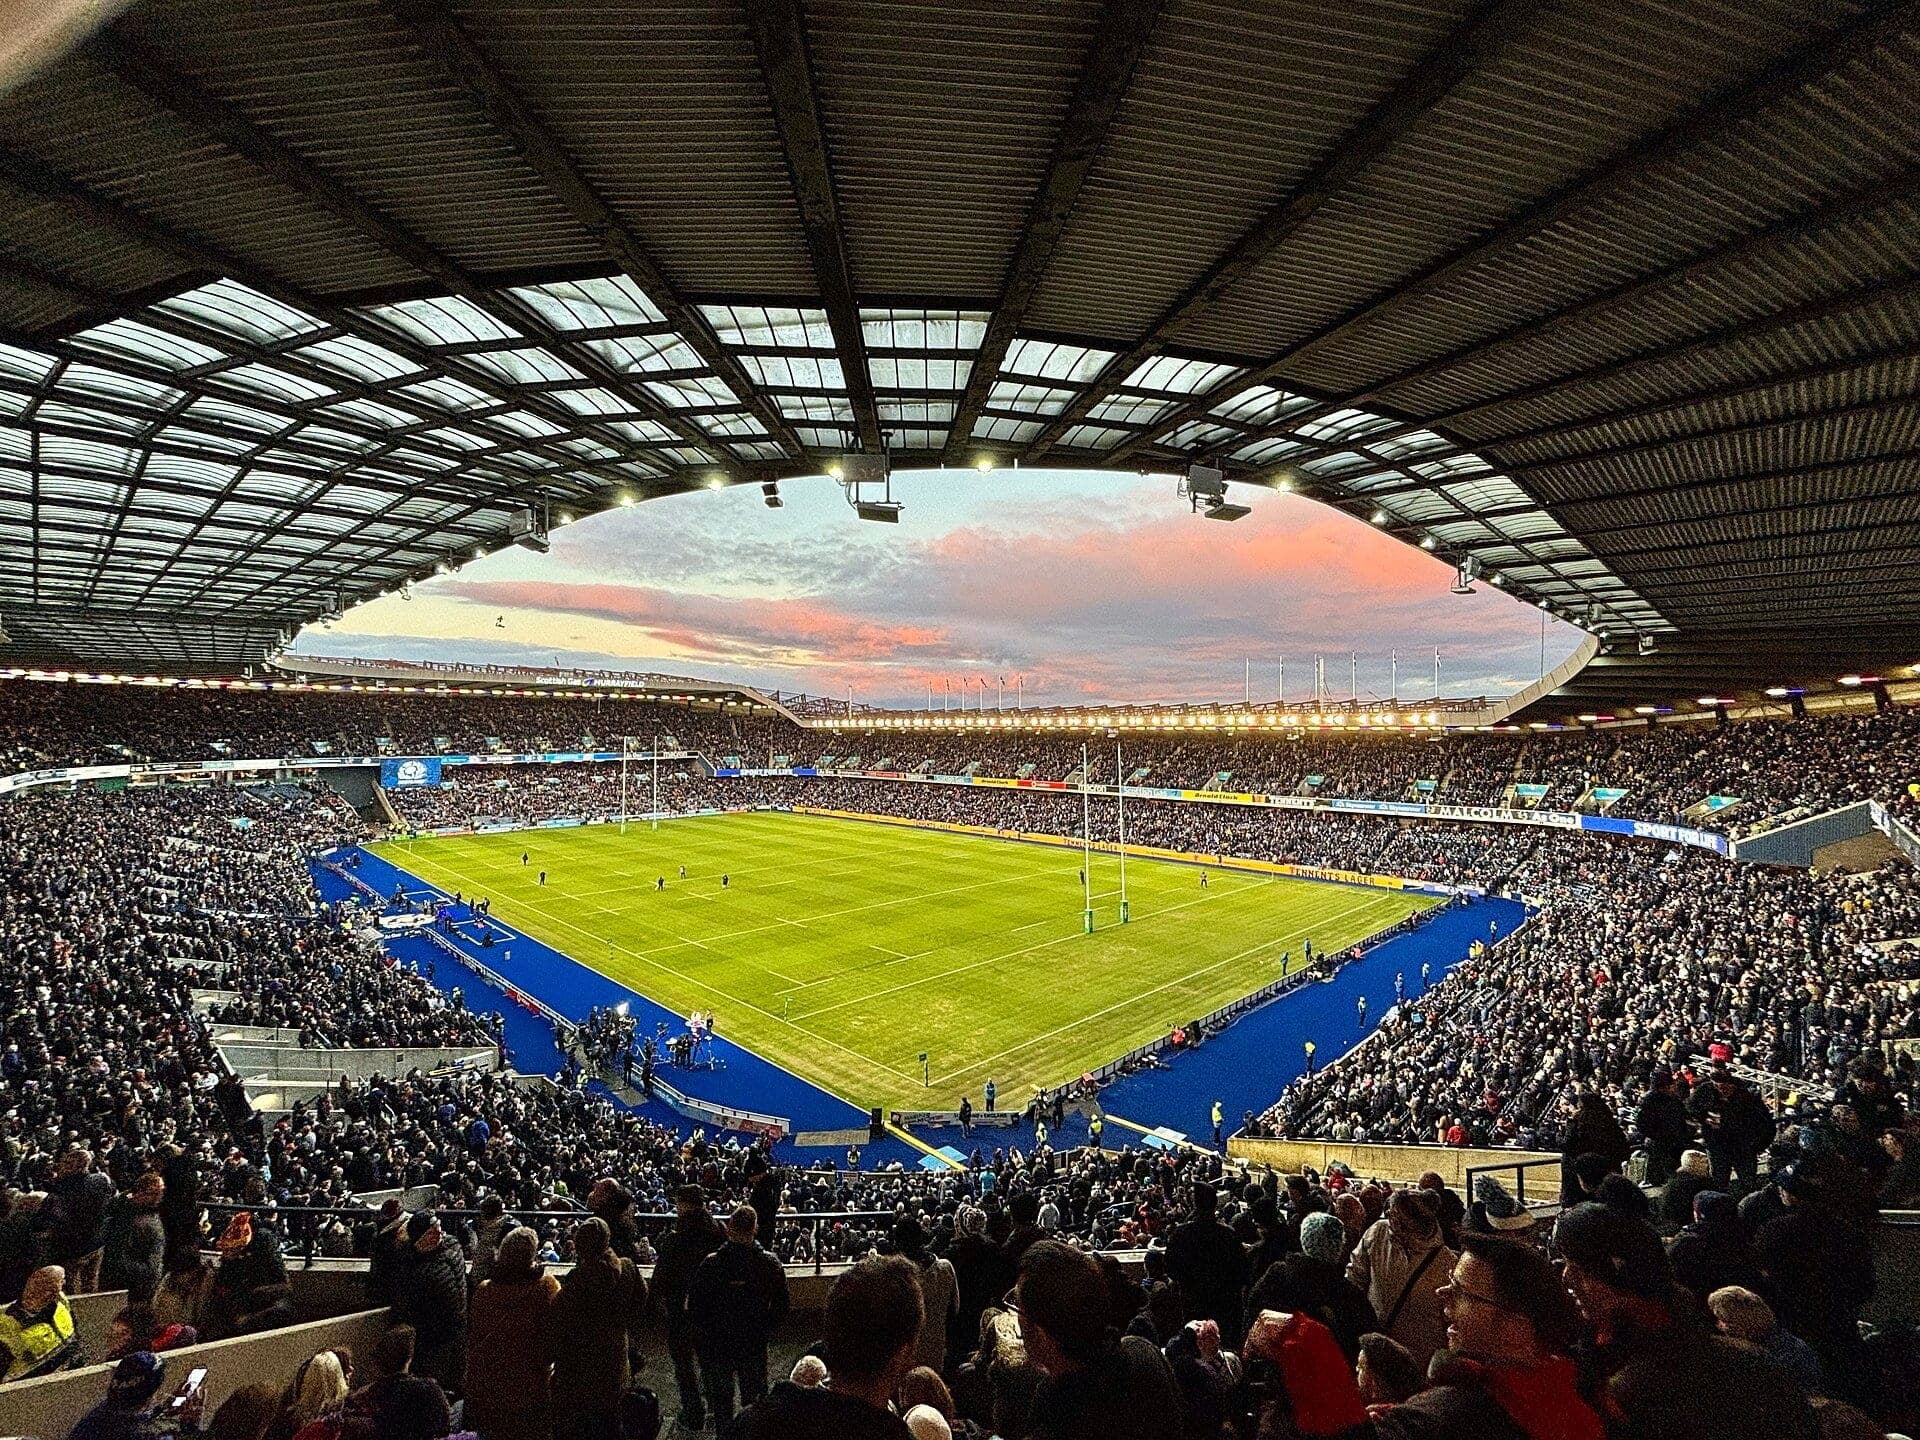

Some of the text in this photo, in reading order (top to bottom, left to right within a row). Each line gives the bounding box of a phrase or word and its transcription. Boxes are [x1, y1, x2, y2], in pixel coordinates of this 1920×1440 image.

[536, 676, 645, 688] Scottish Gas MURRAYFIELD
[1194, 792, 1238, 801] Arnold Clark
[1440, 806, 1513, 821] MALCOLM
[1532, 812, 1575, 825] As One
[1634, 822, 1677, 841] SPORT
[1679, 828, 1699, 845] FOR
[1344, 873, 1376, 885] LAGER
